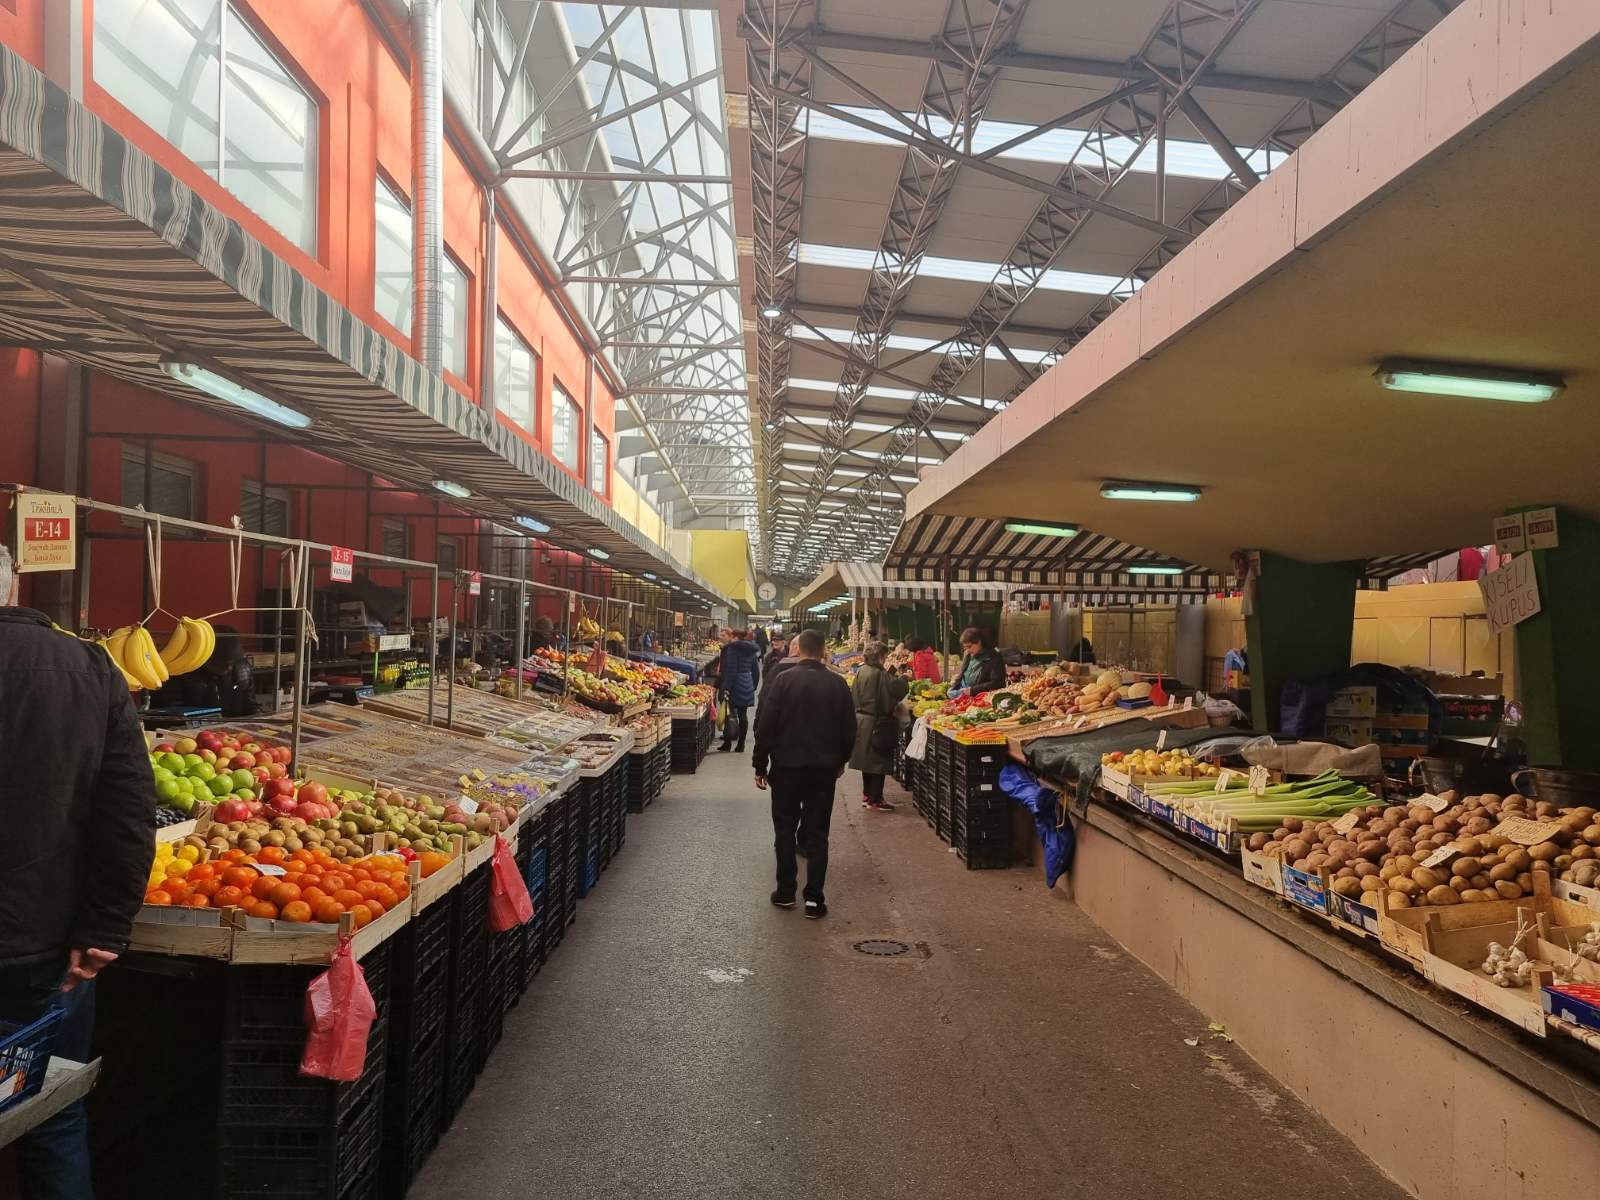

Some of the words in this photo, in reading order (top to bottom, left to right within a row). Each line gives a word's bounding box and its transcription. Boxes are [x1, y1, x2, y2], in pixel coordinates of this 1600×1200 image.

[35, 521, 62, 538] E-14
[1483, 554, 1531, 604] KISELI
[1490, 590, 1536, 633] KUPUS
